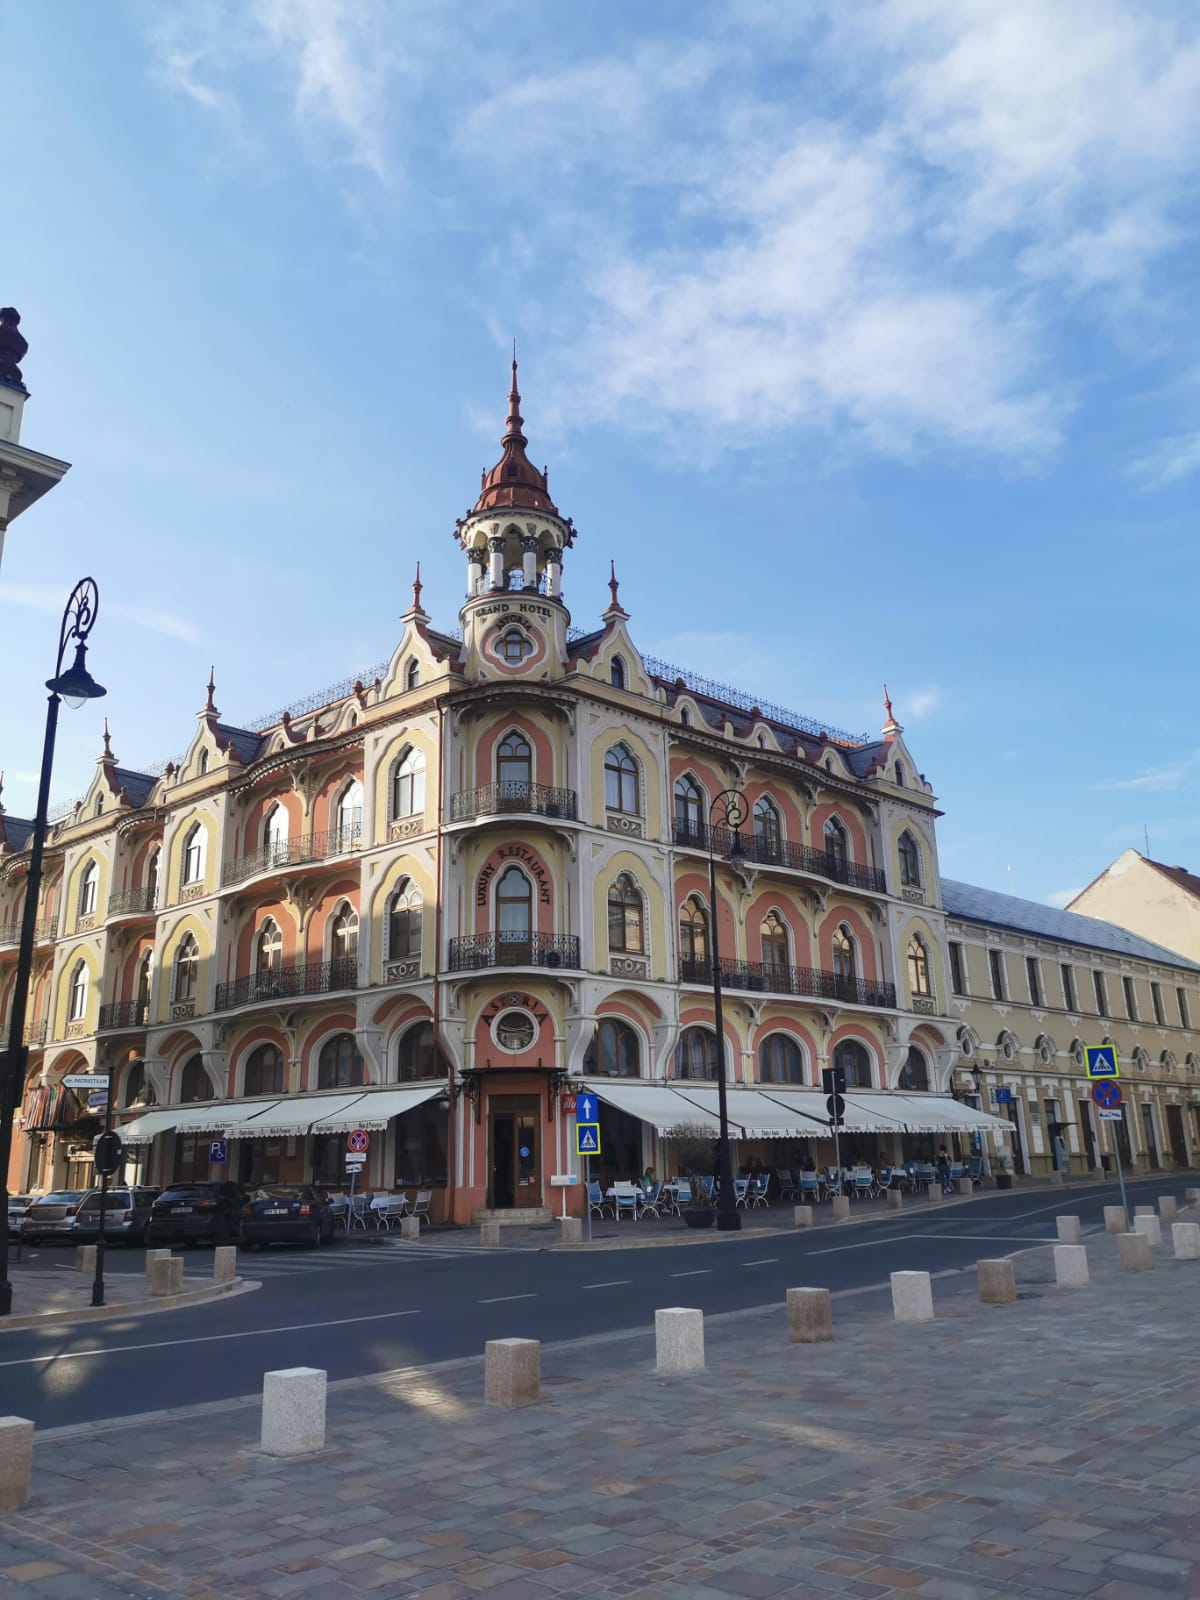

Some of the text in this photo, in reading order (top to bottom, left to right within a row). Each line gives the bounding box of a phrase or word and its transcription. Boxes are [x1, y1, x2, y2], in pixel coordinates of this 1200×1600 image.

[476, 603, 552, 617] GRAND HOTEL
[495, 614, 532, 632] ASTORIA
[477, 846, 551, 906] LUXURY RESTAURANT
[211, 1142, 221, 1154] P
